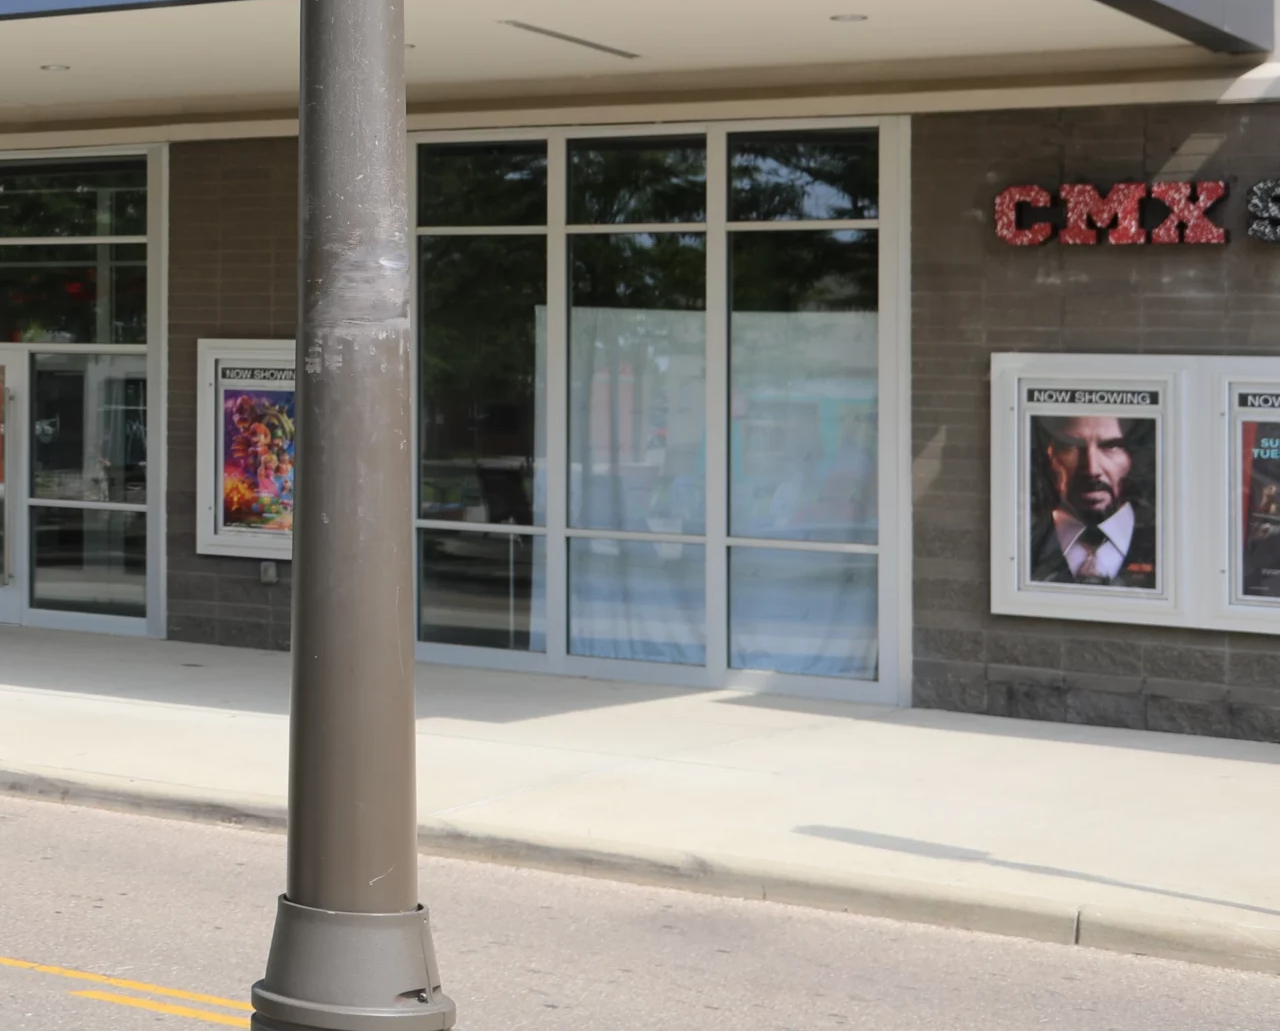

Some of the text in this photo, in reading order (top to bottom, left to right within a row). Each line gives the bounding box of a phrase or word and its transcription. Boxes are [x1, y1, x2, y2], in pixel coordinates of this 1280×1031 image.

[993, 180, 1226, 246] CMX
[225, 369, 296, 380] NOW SHOWIN
[1034, 390, 1151, 405] NOW SHOWING
[1260, 438, 1280, 448] SU
[1252, 448, 1280, 459] TUE
